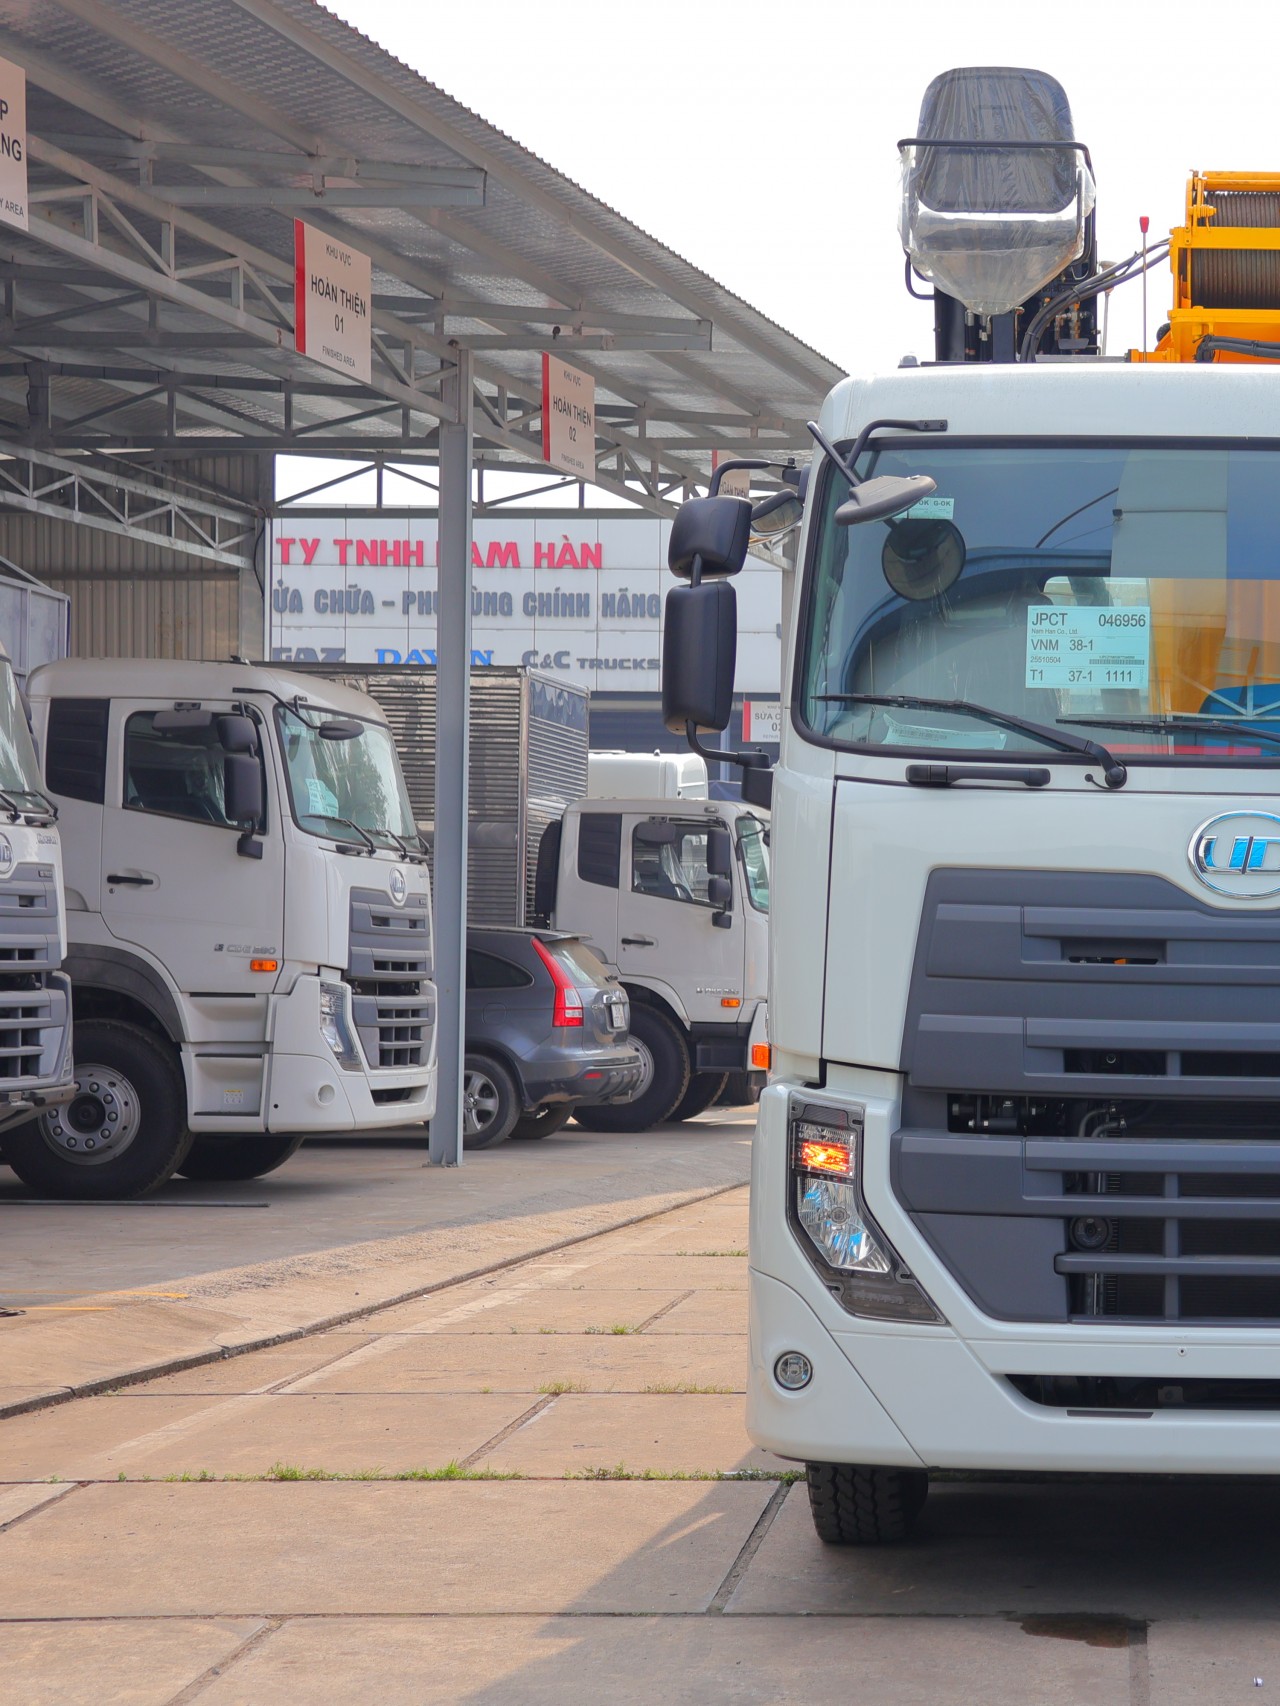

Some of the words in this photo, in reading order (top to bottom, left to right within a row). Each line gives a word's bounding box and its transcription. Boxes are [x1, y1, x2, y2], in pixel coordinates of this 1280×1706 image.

[0, 132, 22, 162] NG
[5, 200, 24, 218] AREA
[325, 243, 338, 260] KHU
[339, 250, 352, 267] VỰC
[311, 273, 338, 304] HOÀN
[340, 287, 366, 319] THIỆN
[334, 313, 345, 334] 01
[322, 345, 343, 362] FINISHED
[342, 355, 356, 369] AREA
[553, 395, 572, 418] HOÀN
[573, 403, 592, 428] THIỆN
[568, 425, 577, 442] 02
[276, 538, 321, 566] TY
[333, 539, 424, 567] TNHH
[436, 541, 521, 568] AM
[534, 534, 602, 569] HÀN
[273, 578, 304, 614] ỬA
[314, 583, 375, 615] CHỮA
[471, 585, 513, 617] ÙNG
[522, 586, 590, 618] CHÍNH
[601, 587, 661, 619] HÃNG
[1031, 612, 1069, 626] JPCT
[1098, 613, 1146, 628] 046956
[1030, 638, 1059, 651] VNM
[1069, 639, 1094, 651] 38-1
[374, 648, 494, 667] DAYN
[521, 650, 571, 669] C&C
[576, 658, 661, 671] TRUCKS
[1030, 655, 1061, 664] 25510504
[1030, 669, 1044, 682] T1
[1068, 670, 1093, 682] 37-1
[1105, 670, 1132, 682] 1111
